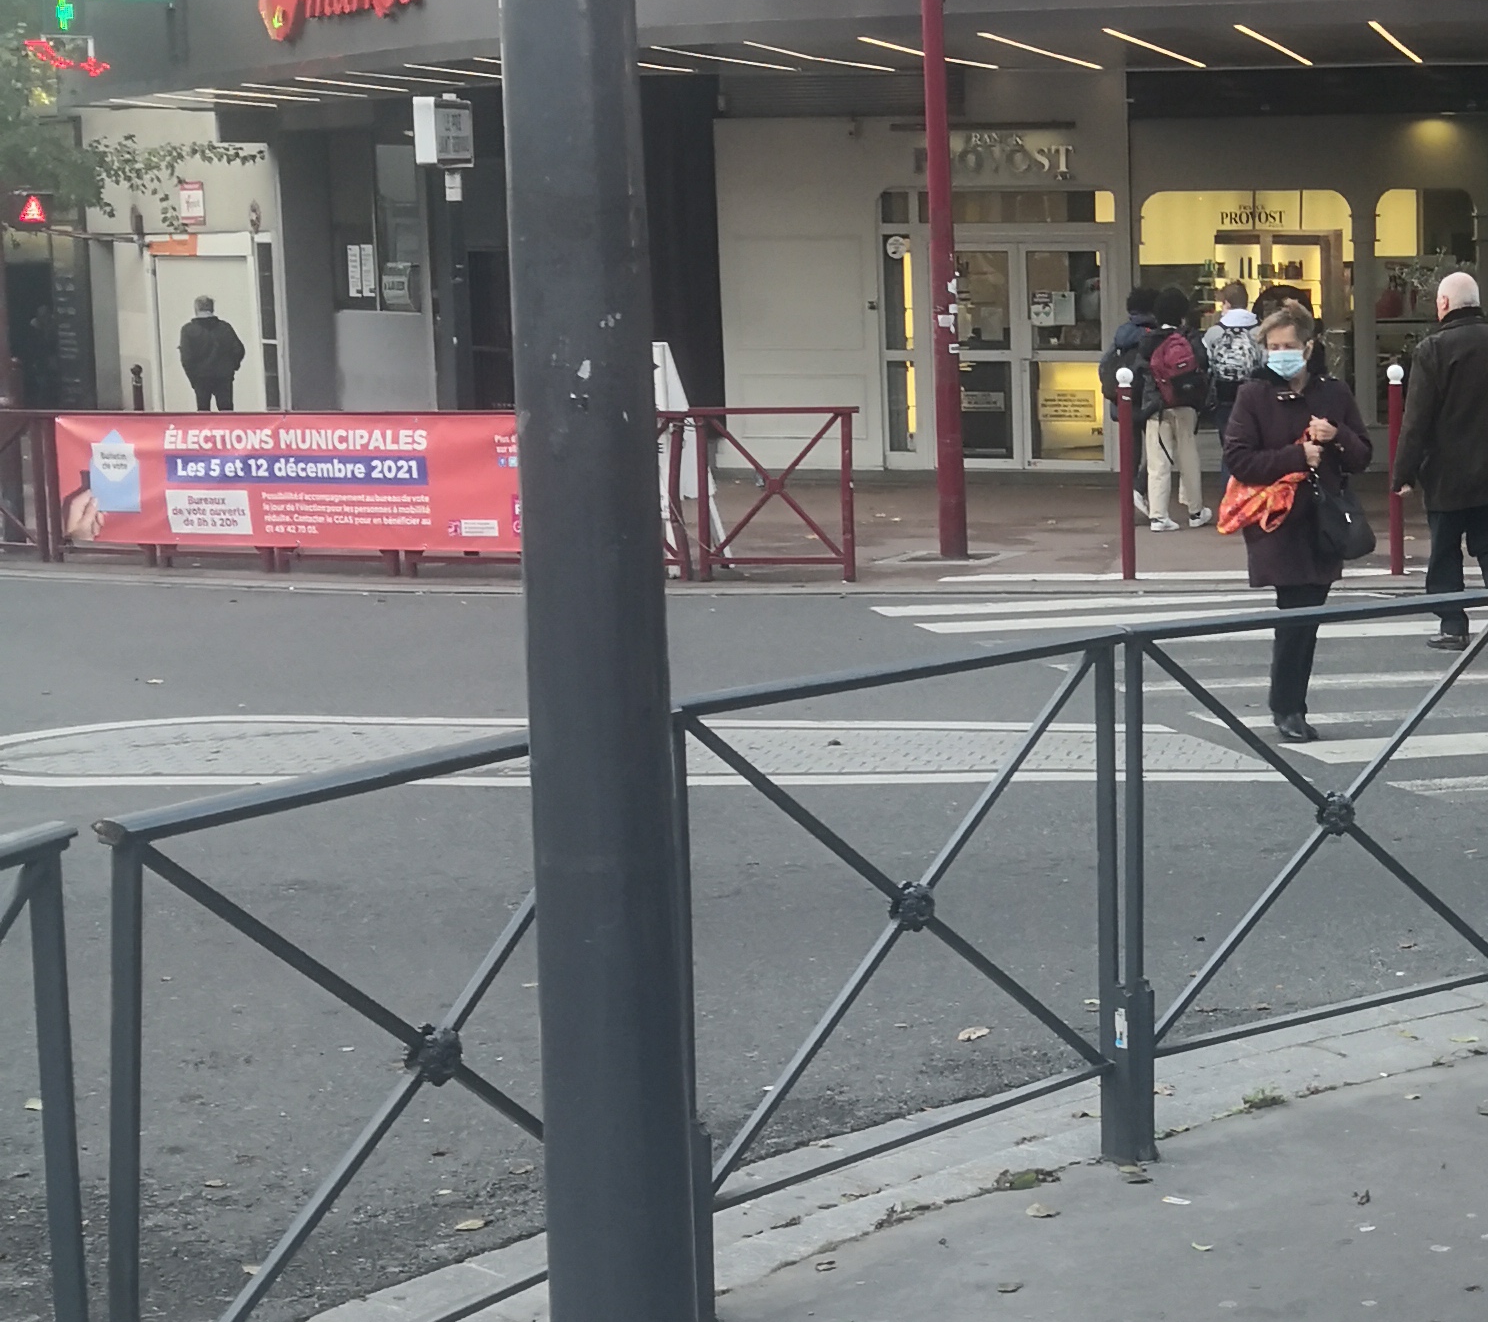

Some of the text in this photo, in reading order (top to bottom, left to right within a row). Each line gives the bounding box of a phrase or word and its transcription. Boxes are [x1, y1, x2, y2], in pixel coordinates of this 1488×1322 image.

[164, 424, 428, 451] ÉLECTIONS MUNICIPALES
[176, 457, 419, 479] Les 5 et 12 décembre 2021
[187, 495, 226, 505] Bureaux
